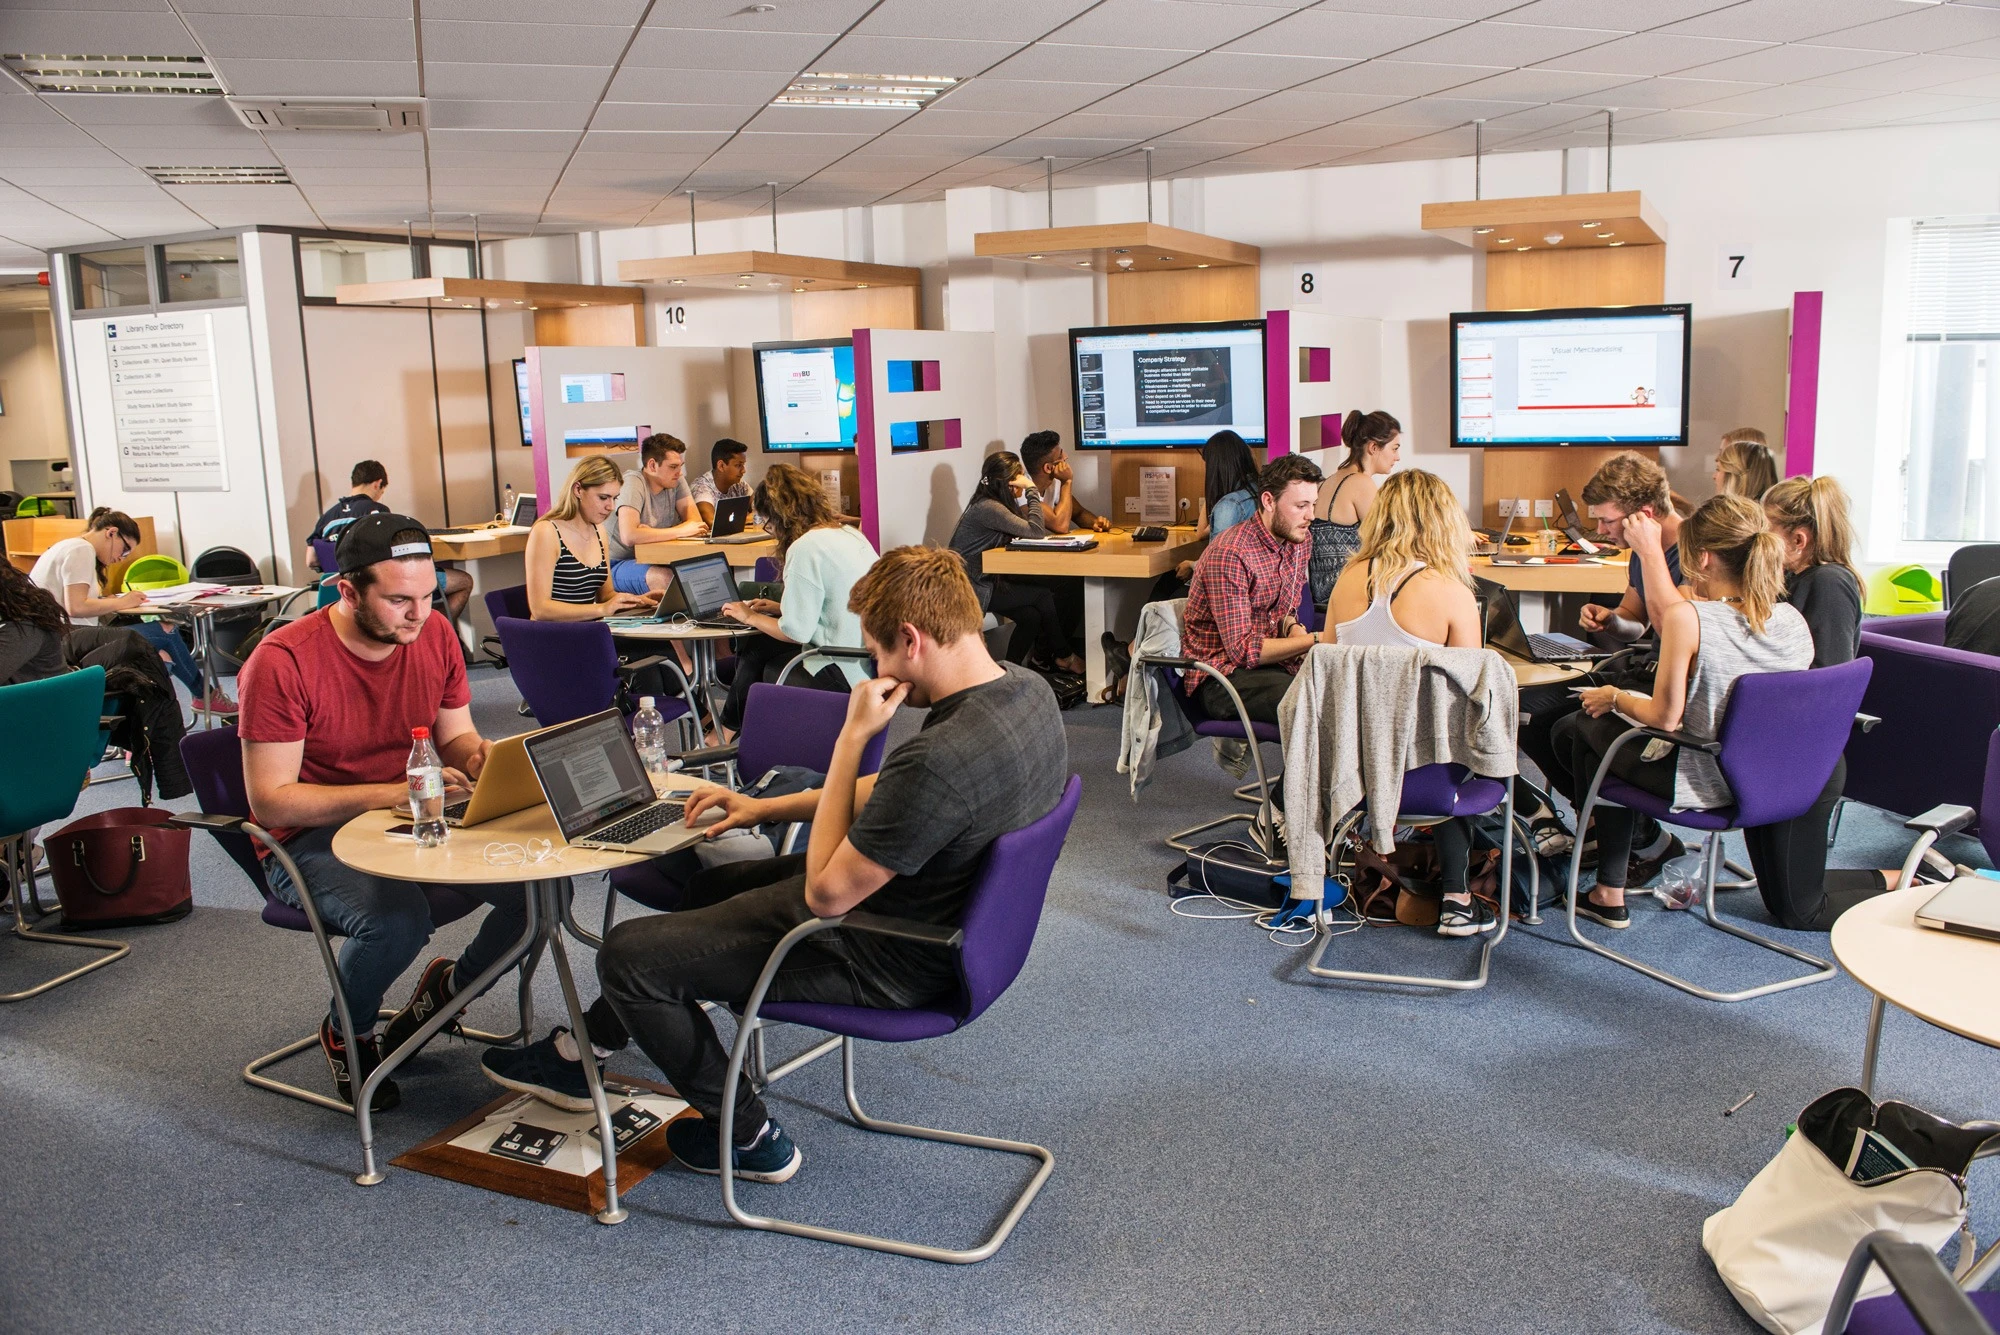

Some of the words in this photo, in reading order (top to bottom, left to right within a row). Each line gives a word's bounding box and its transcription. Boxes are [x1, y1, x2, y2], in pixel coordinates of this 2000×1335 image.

[1729, 255, 1745, 278] 7
[1301, 272, 1314, 294] 8
[666, 306, 685, 325] 10
[160, 323, 184, 331] Directory
[112, 344, 116, 353] 4
[1551, 346, 1572, 355] Visual
[1573, 346, 1623, 354] Merchandising
[114, 360, 118, 368] 3
[1138, 356, 1163, 364] Company
[116, 374, 120, 382] 2
[120, 418, 124, 426] 1
[124, 446, 129, 456] G
